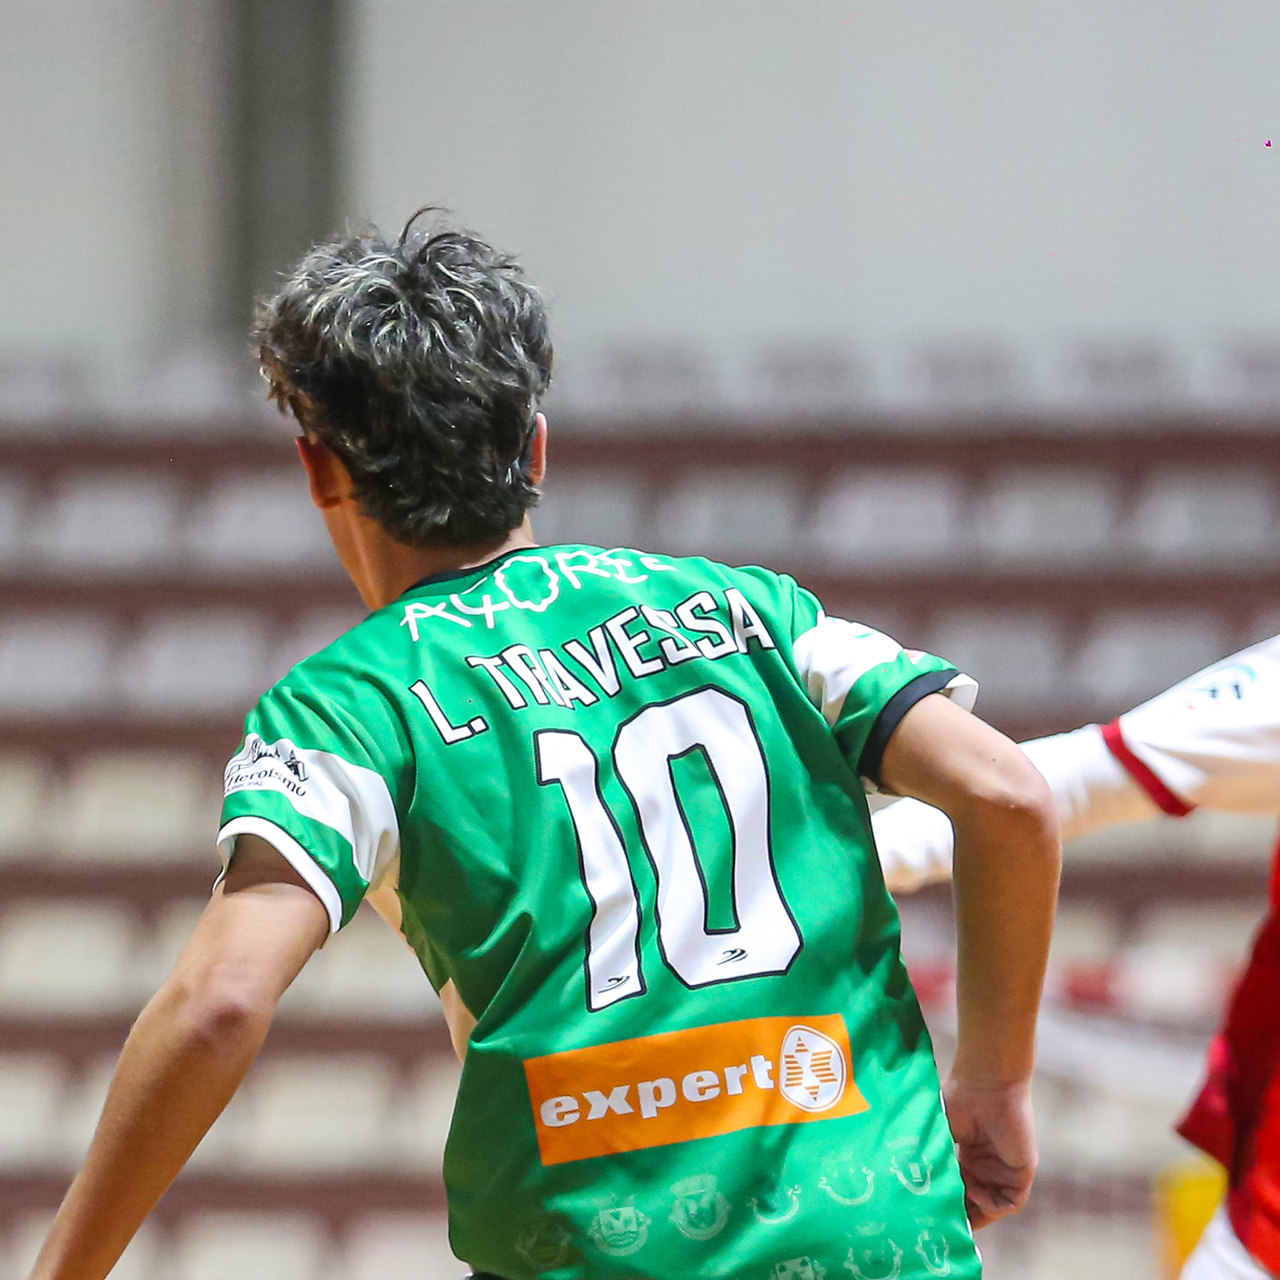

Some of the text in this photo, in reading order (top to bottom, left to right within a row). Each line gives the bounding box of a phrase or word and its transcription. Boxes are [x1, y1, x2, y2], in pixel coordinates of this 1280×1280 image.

[407, 587, 776, 746] L. TRAVESSA
[534, 684, 806, 1014] 10
[539, 1054, 775, 1128] expert
